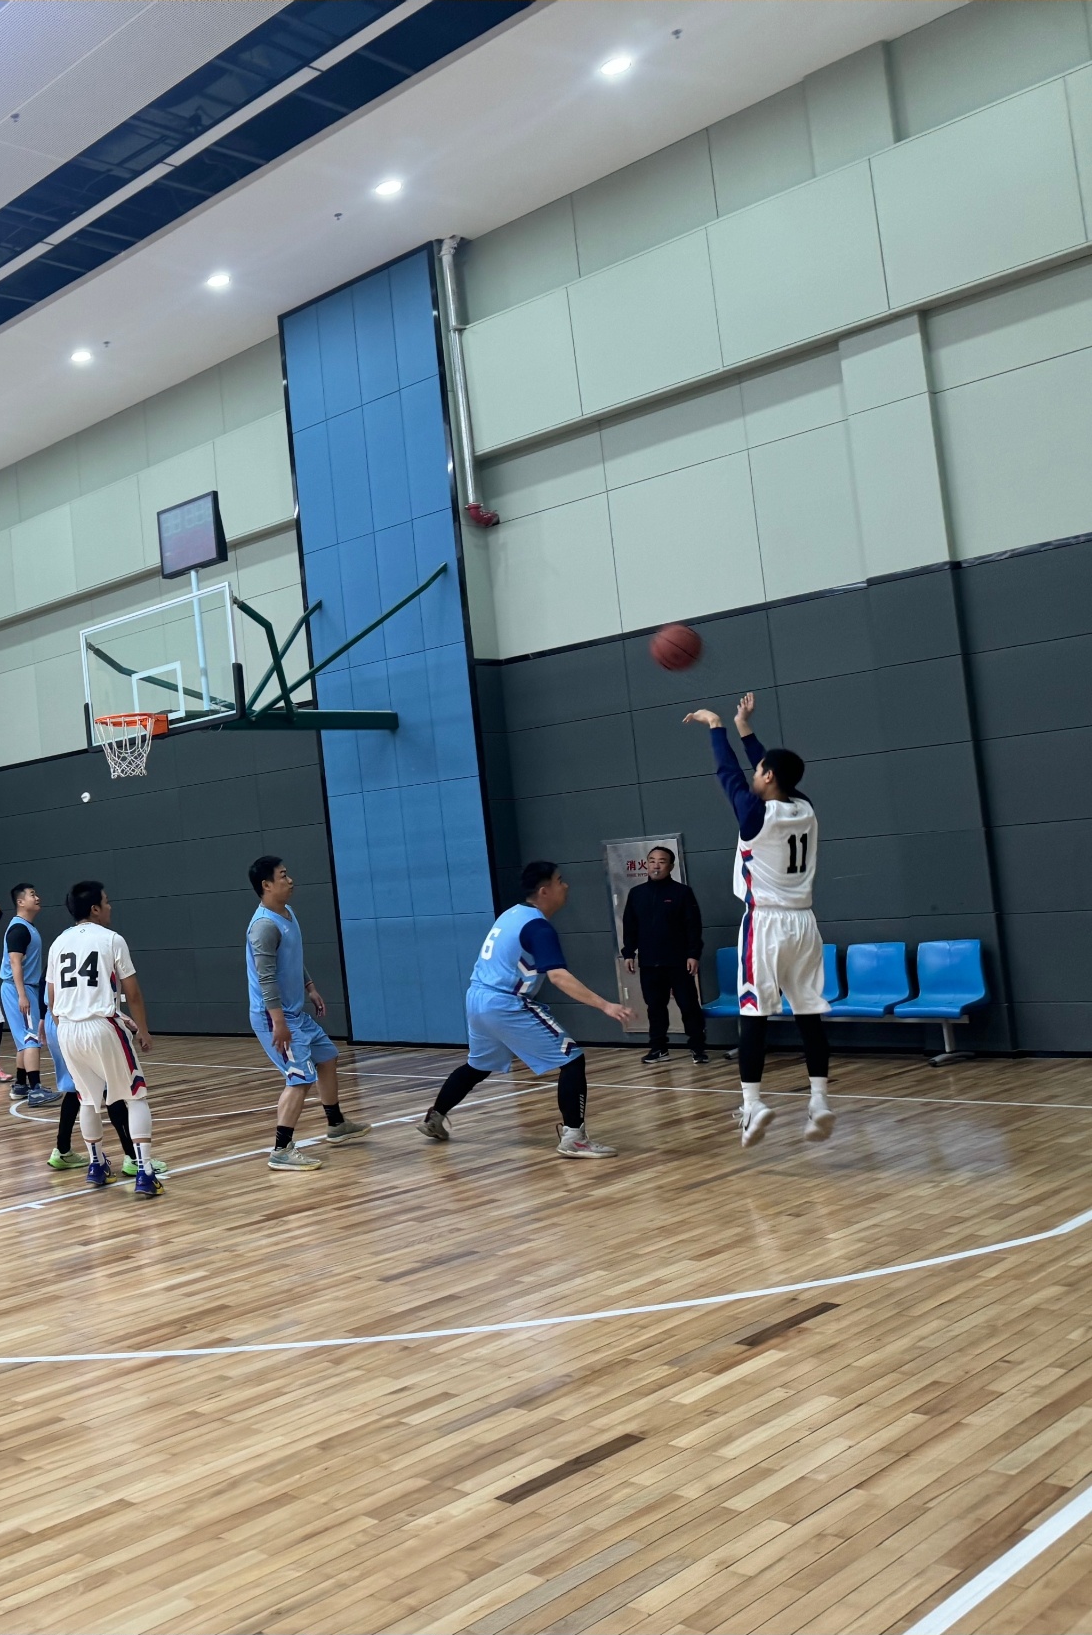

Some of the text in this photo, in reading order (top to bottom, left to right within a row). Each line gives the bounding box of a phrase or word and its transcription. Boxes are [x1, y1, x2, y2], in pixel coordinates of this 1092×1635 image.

[626, 859, 648, 871] 消火
[786, 832, 809, 875] 11
[60, 951, 100, 989] 24
